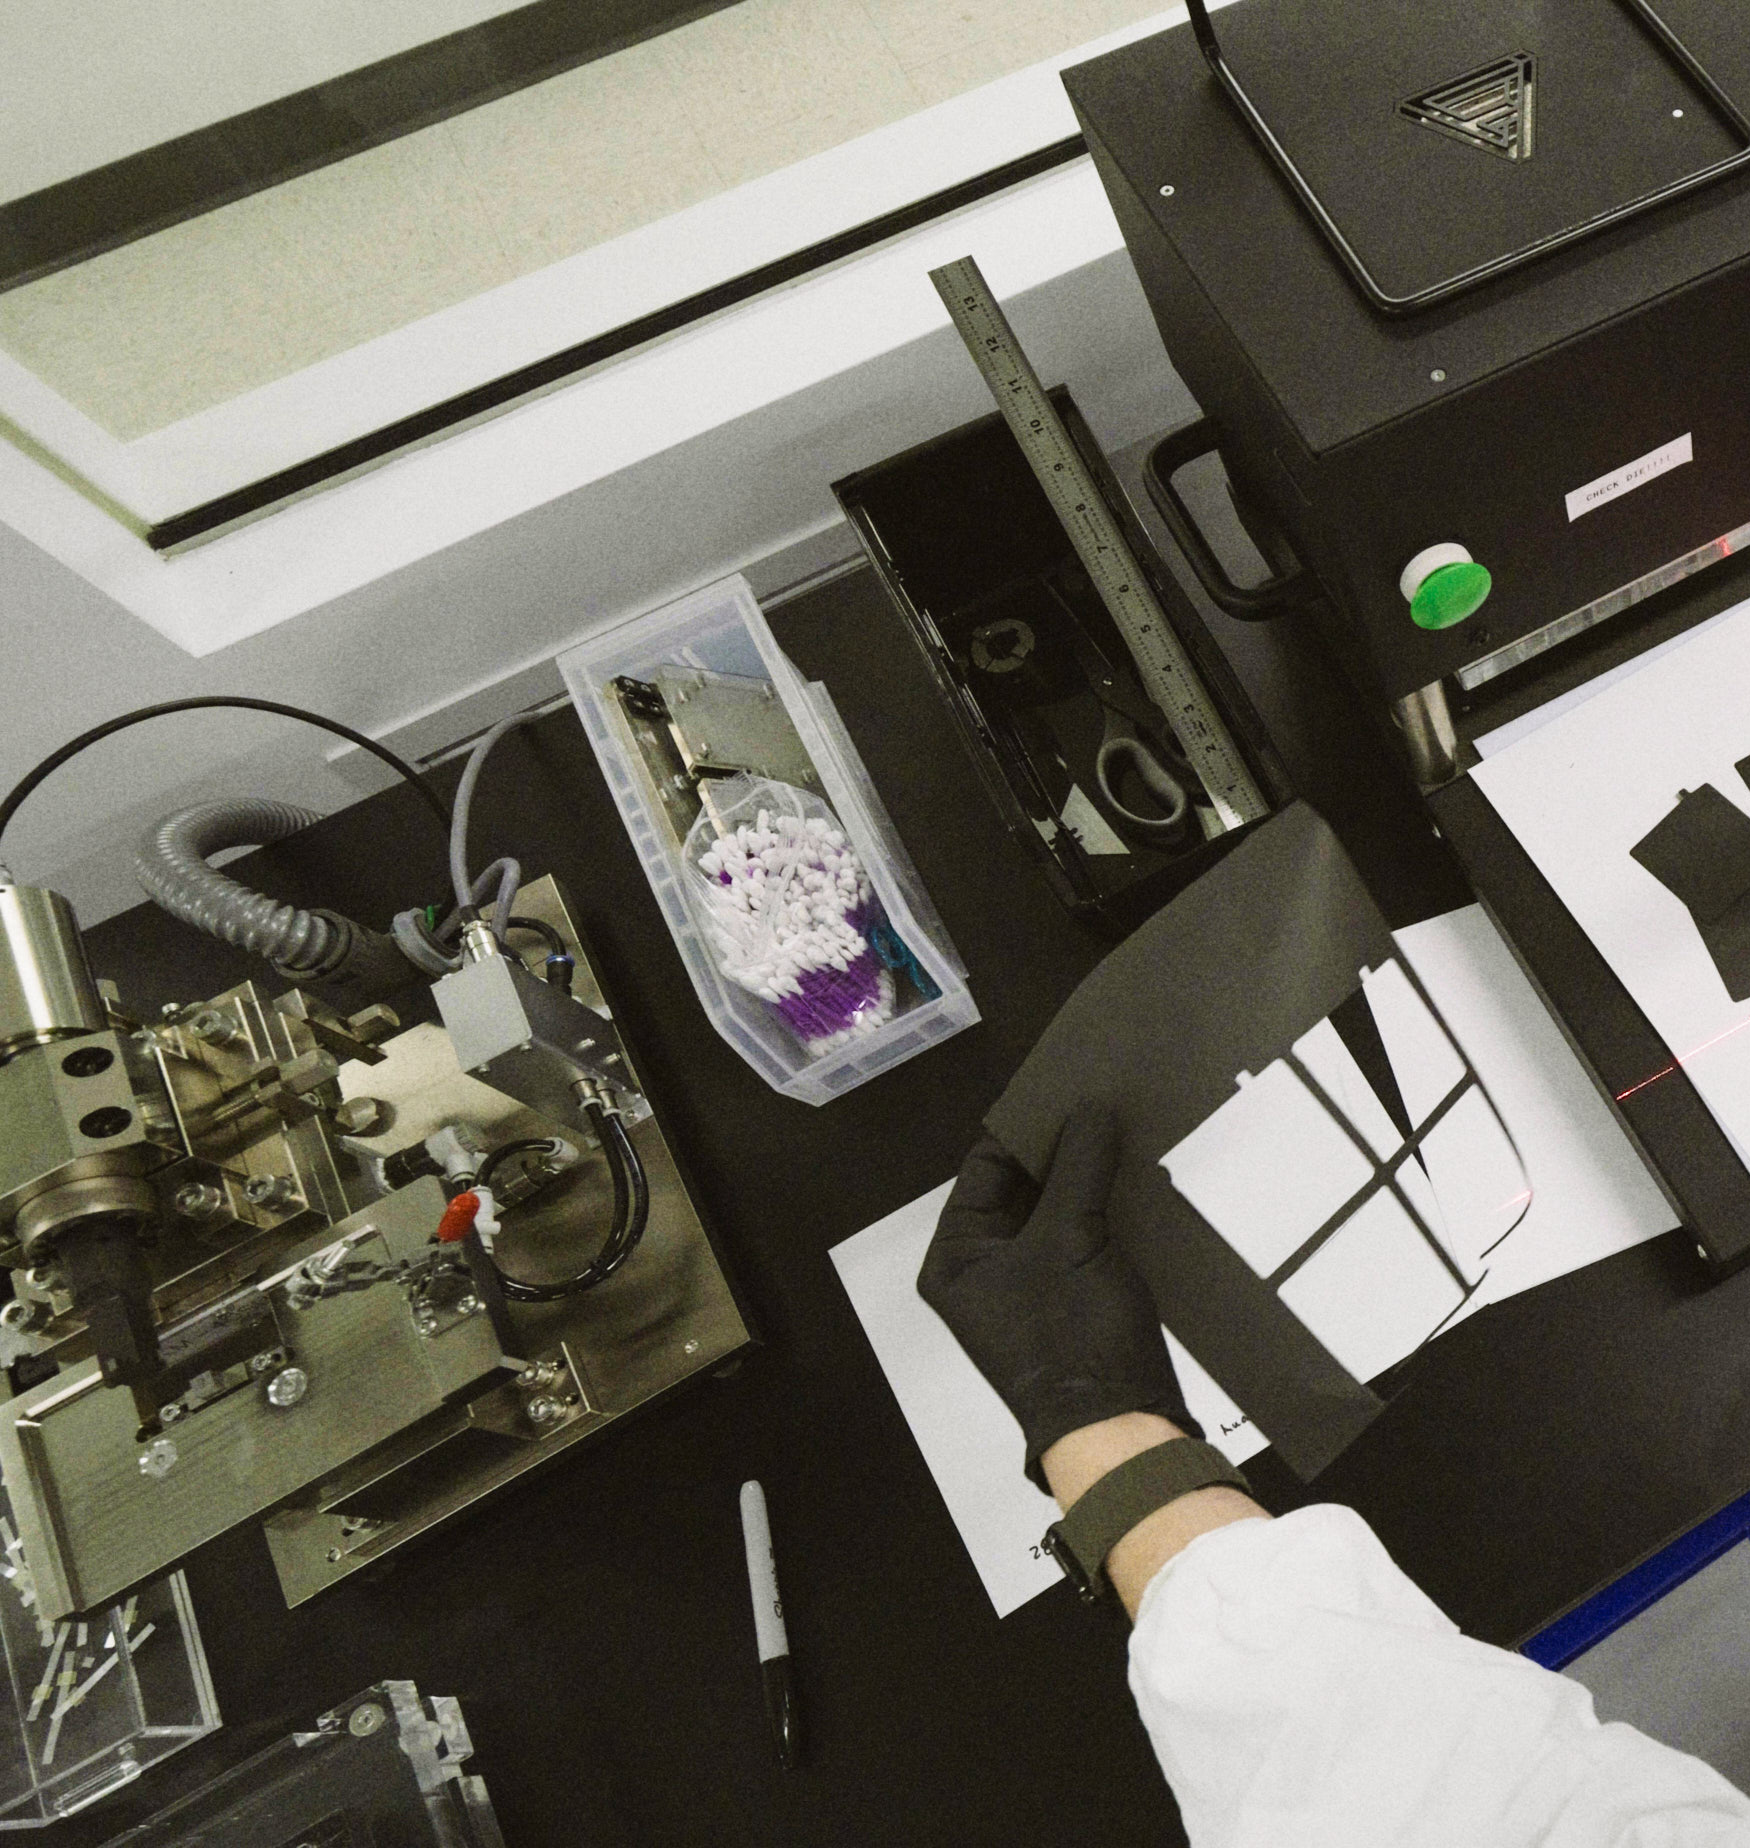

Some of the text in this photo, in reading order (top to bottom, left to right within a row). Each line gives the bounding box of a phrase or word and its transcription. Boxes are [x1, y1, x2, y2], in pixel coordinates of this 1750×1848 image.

[963, 295, 979, 312] 13
[986, 336, 1000, 353] 12
[1007, 378, 1022, 394] 11
[1030, 419, 1045, 435] 10
[1586, 482, 1620, 502] CHECK
[1075, 503, 1086, 512] 8
[1097, 545, 1108, 554] 7
[1140, 624, 1151, 634] 5
[1162, 664, 1173, 673] 4
[1183, 703, 1194, 713] 3
[1205, 743, 1216, 753] 2
